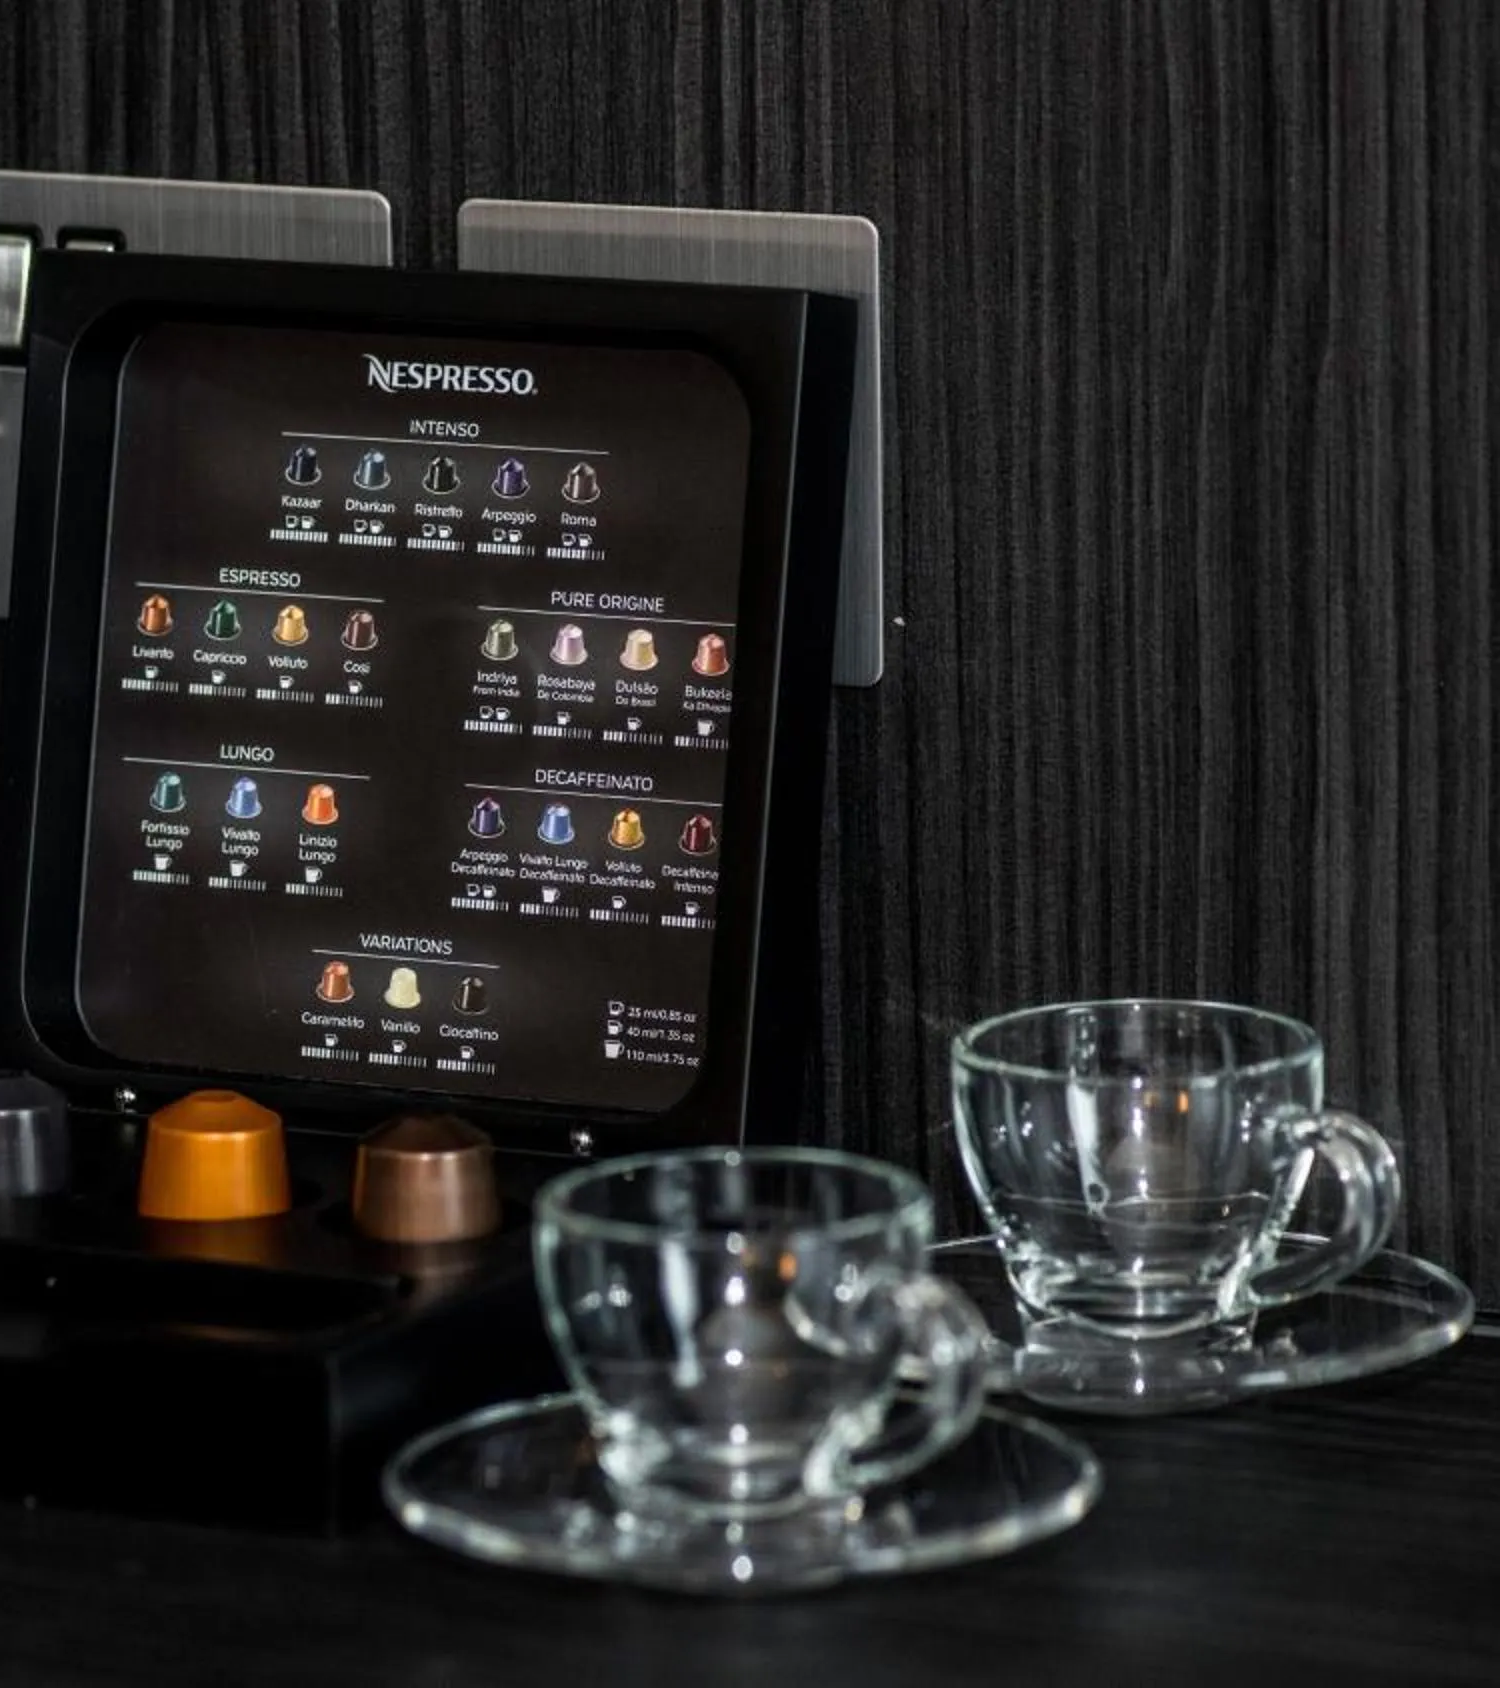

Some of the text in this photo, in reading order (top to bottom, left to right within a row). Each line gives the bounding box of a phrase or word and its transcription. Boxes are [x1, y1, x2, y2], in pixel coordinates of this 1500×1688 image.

[363, 353, 534, 395] NESPRESSO
[409, 419, 480, 438] INTENSO
[281, 495, 322, 510] Kazaar
[345, 498, 396, 514] Dharkan
[415, 503, 463, 519] Ristretto
[481, 507, 537, 525] Arpeggio
[561, 512, 597, 527] Roma
[219, 568, 301, 588] ESPRESSO
[551, 591, 665, 613] PURE ORIGINE
[132, 645, 174, 660] Livanto
[193, 648, 247, 666] Capriccio
[267, 655, 308, 670] Volluto
[477, 670, 518, 686] Indriya
[537, 673, 596, 692] Rosabaya
[220, 744, 275, 762] LUNGO
[535, 769, 654, 791] DECAFFEINATO
[140, 819, 190, 835] Fortissio
[221, 826, 261, 841] Vivalto
[146, 835, 183, 850] Lungo
[299, 833, 338, 849] Linizio
[221, 842, 259, 858] Lungo
[299, 848, 336, 864] Lungo
[359, 933, 453, 955] VARIATIONS
[301, 1011, 365, 1029] Caramelito
[381, 1018, 420, 1034] Vanilio
